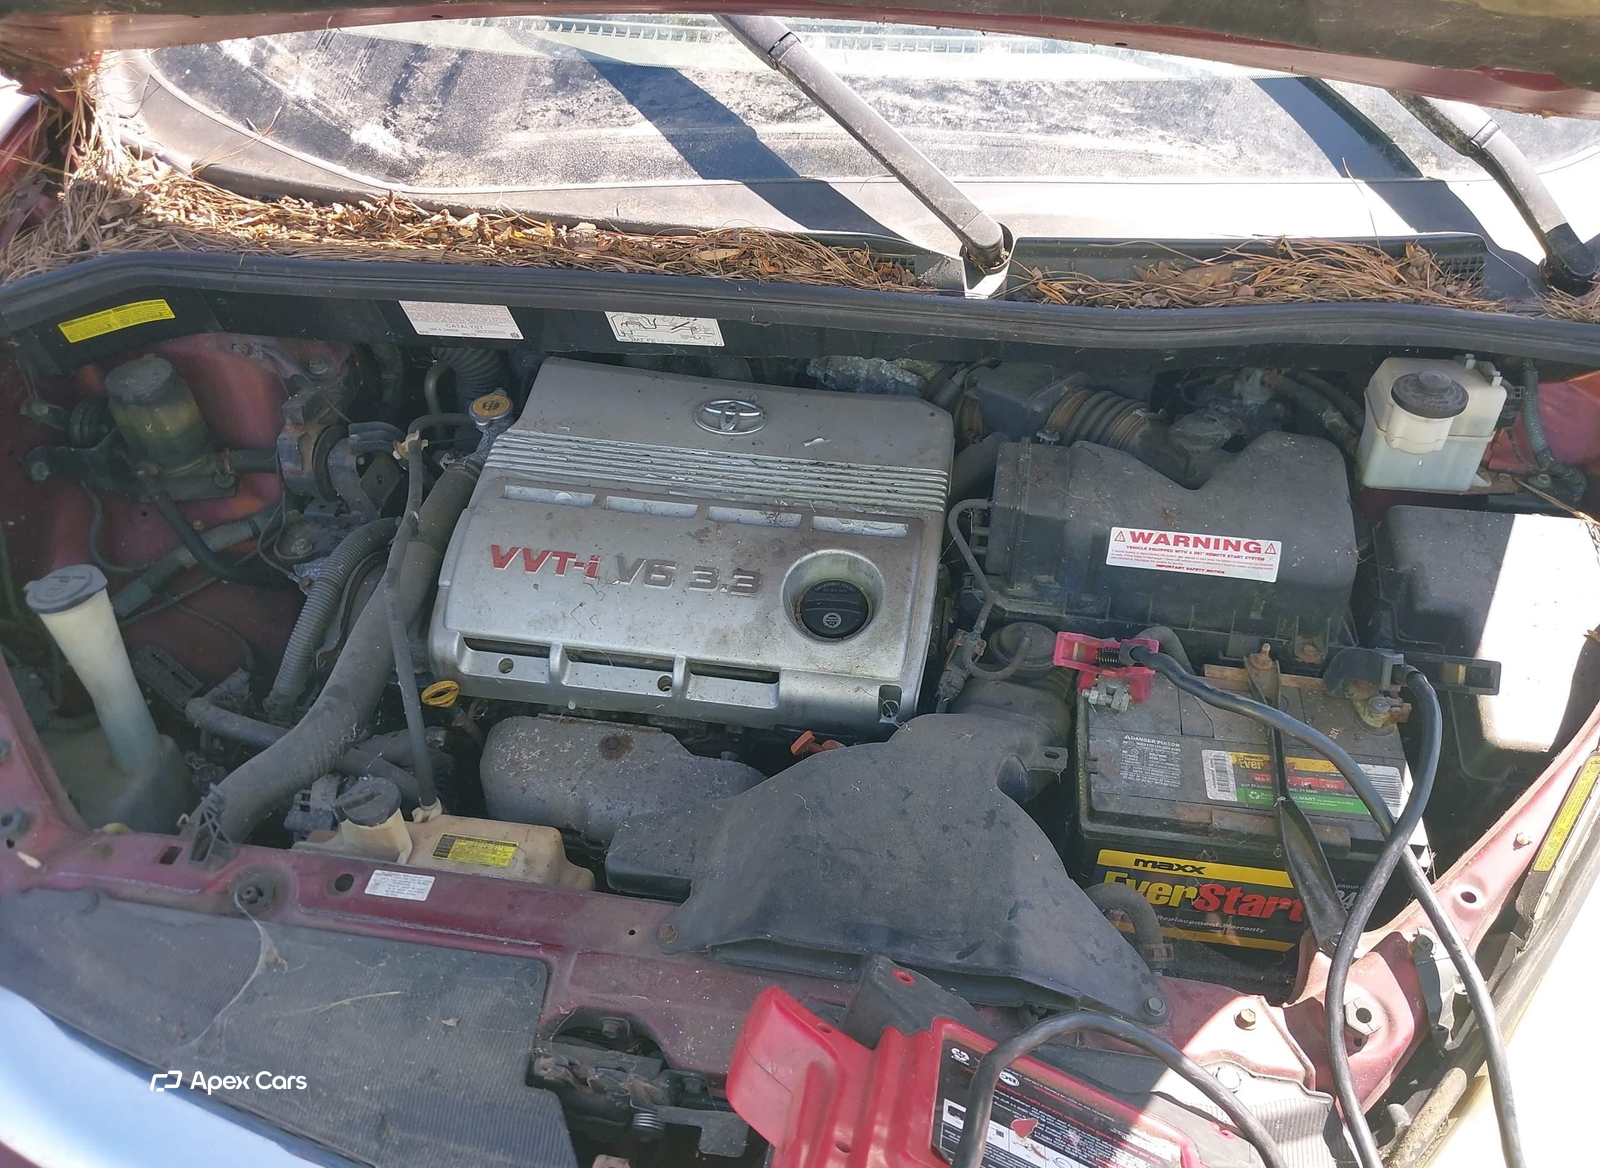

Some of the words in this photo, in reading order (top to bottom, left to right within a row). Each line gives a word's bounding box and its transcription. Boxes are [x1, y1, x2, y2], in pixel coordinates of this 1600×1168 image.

[445, 323, 484, 331] CATALYST
[1130, 531, 1262, 554] WARNING
[491, 544, 600, 580] VVT-i
[615, 554, 678, 588] V6
[688, 565, 764, 597] 3.3
[1133, 858, 1207, 875] maxx
[1103, 871, 1305, 922] EverStart
[1221, 922, 1266, 934] Warranty
